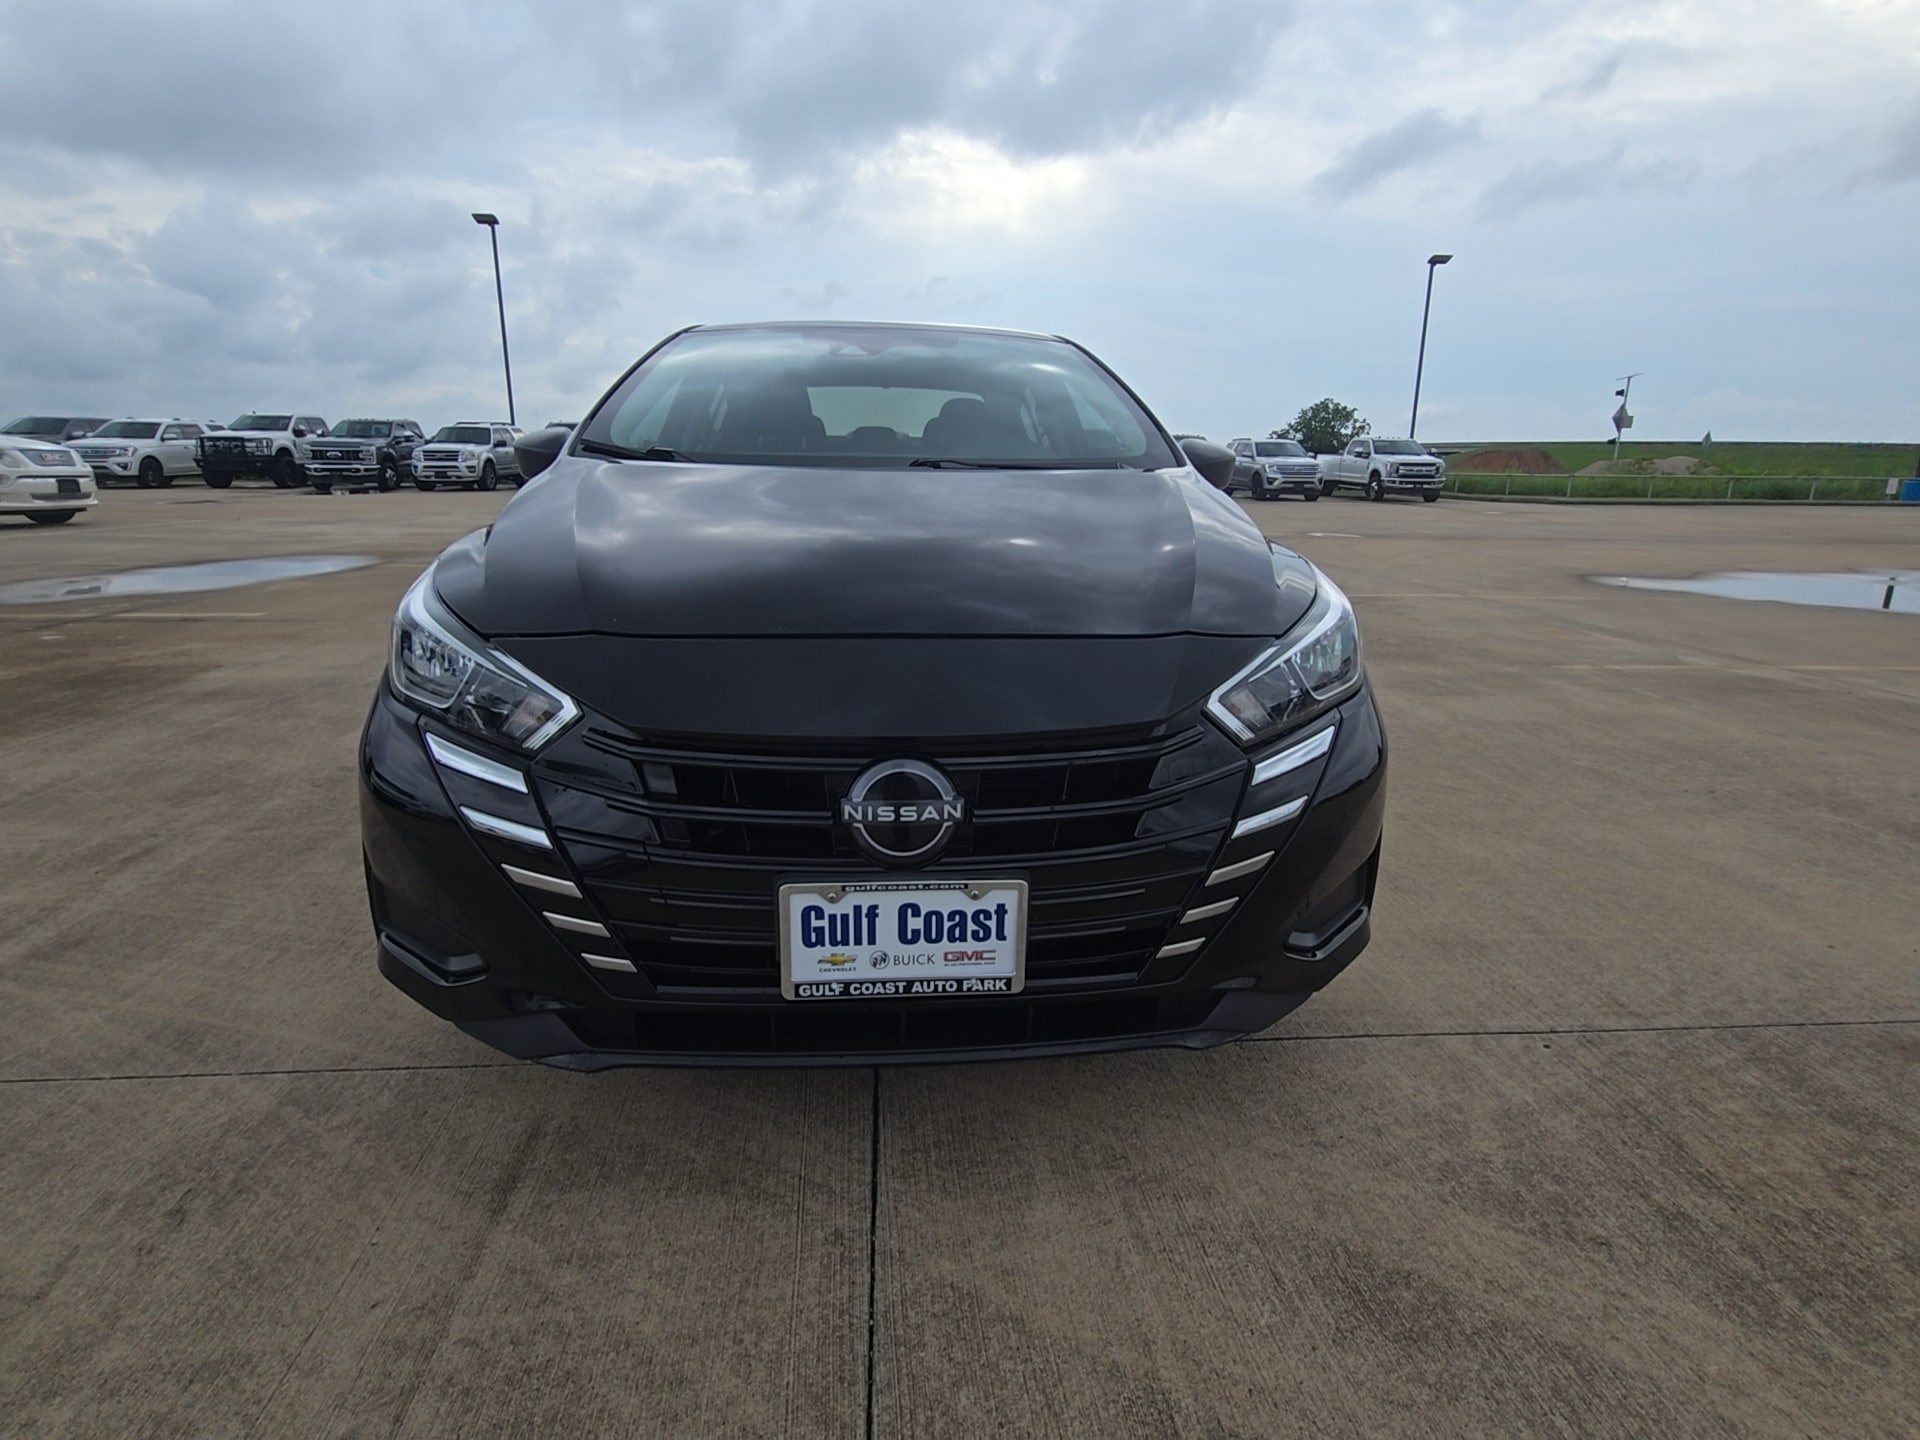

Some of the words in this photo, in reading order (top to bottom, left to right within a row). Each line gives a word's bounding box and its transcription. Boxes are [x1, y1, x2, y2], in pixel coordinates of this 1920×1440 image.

[844, 804, 961, 822] NISSAN
[845, 883, 965, 892] gulfcoast.com
[801, 904, 879, 948] Gulf
[897, 902, 1008, 946] Coast
[893, 953, 935, 966] BUICK
[944, 950, 996, 962] GMC
[799, 982, 844, 997] GULF
[850, 981, 906, 996] COAST
[911, 980, 957, 993] AUTO
[963, 978, 1008, 992] PARK
